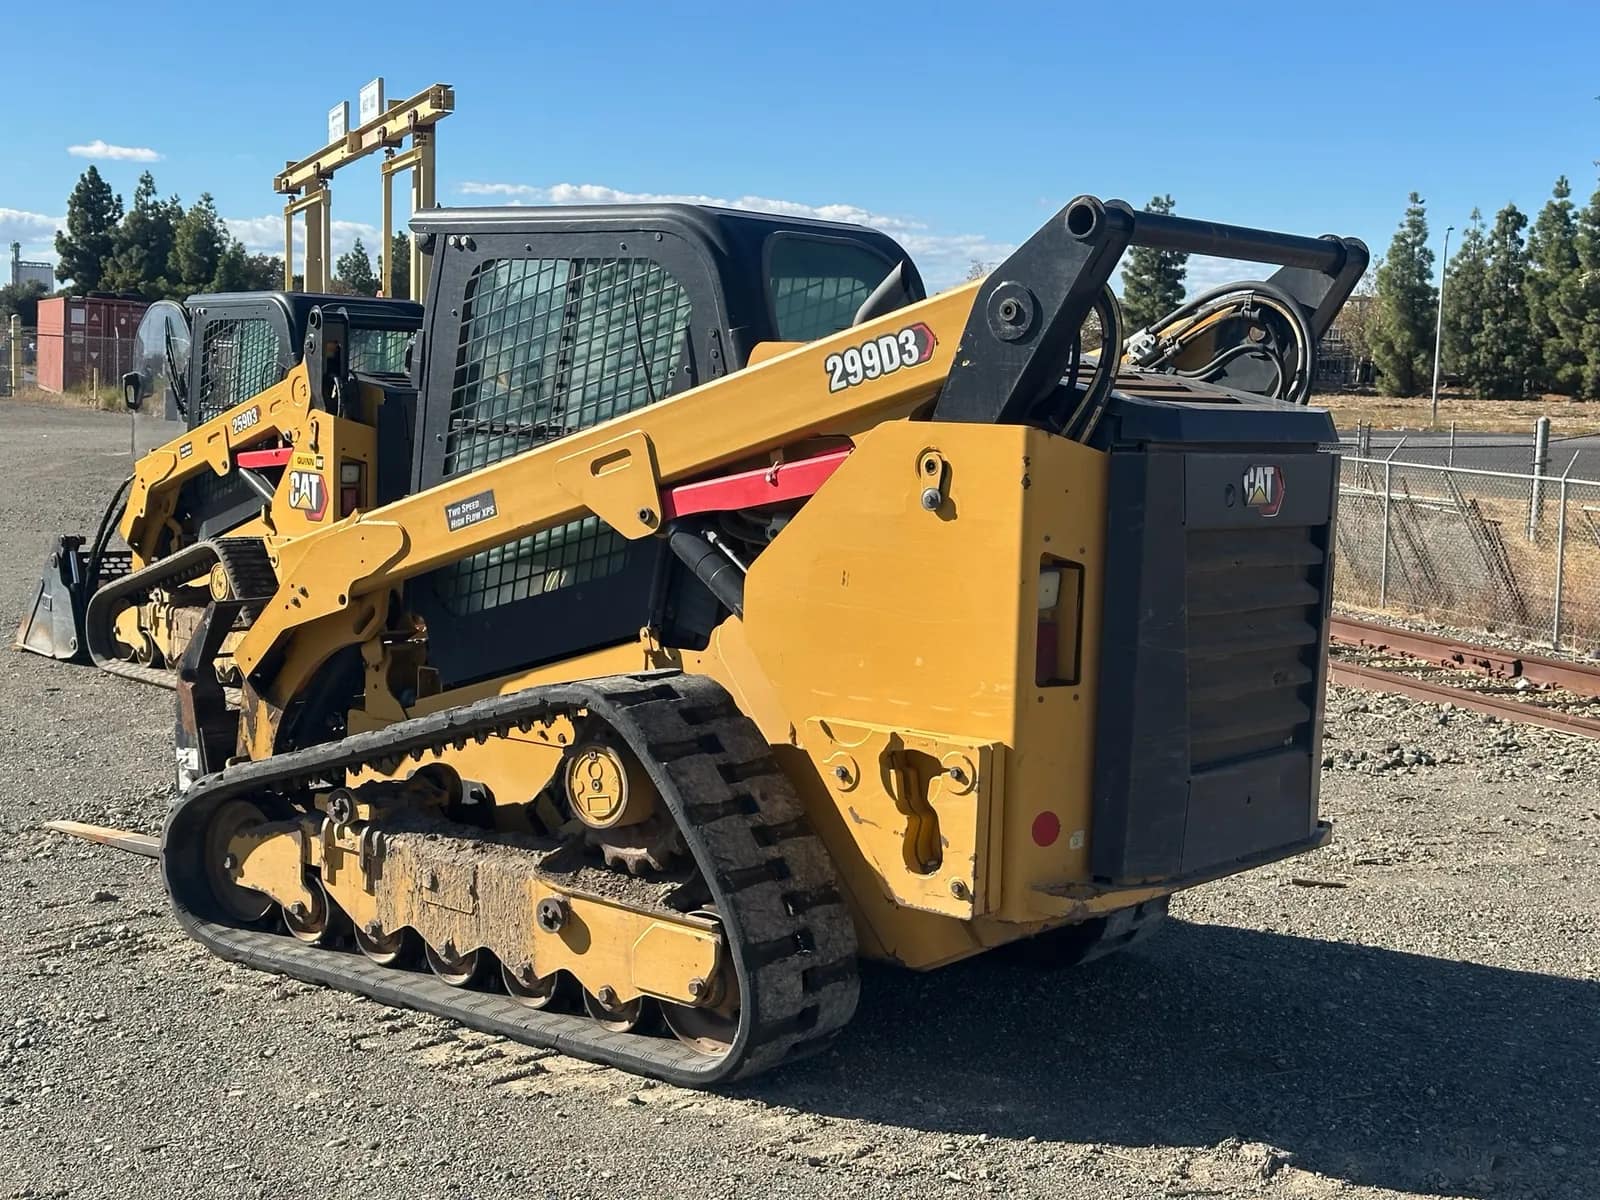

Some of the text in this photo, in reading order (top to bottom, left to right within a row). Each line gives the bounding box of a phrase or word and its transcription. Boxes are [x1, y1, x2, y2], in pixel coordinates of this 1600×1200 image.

[825, 328, 920, 393] 299D3
[232, 406, 258, 435] 259D3
[289, 470, 321, 511] CAT
[1243, 466, 1275, 505] CAT
